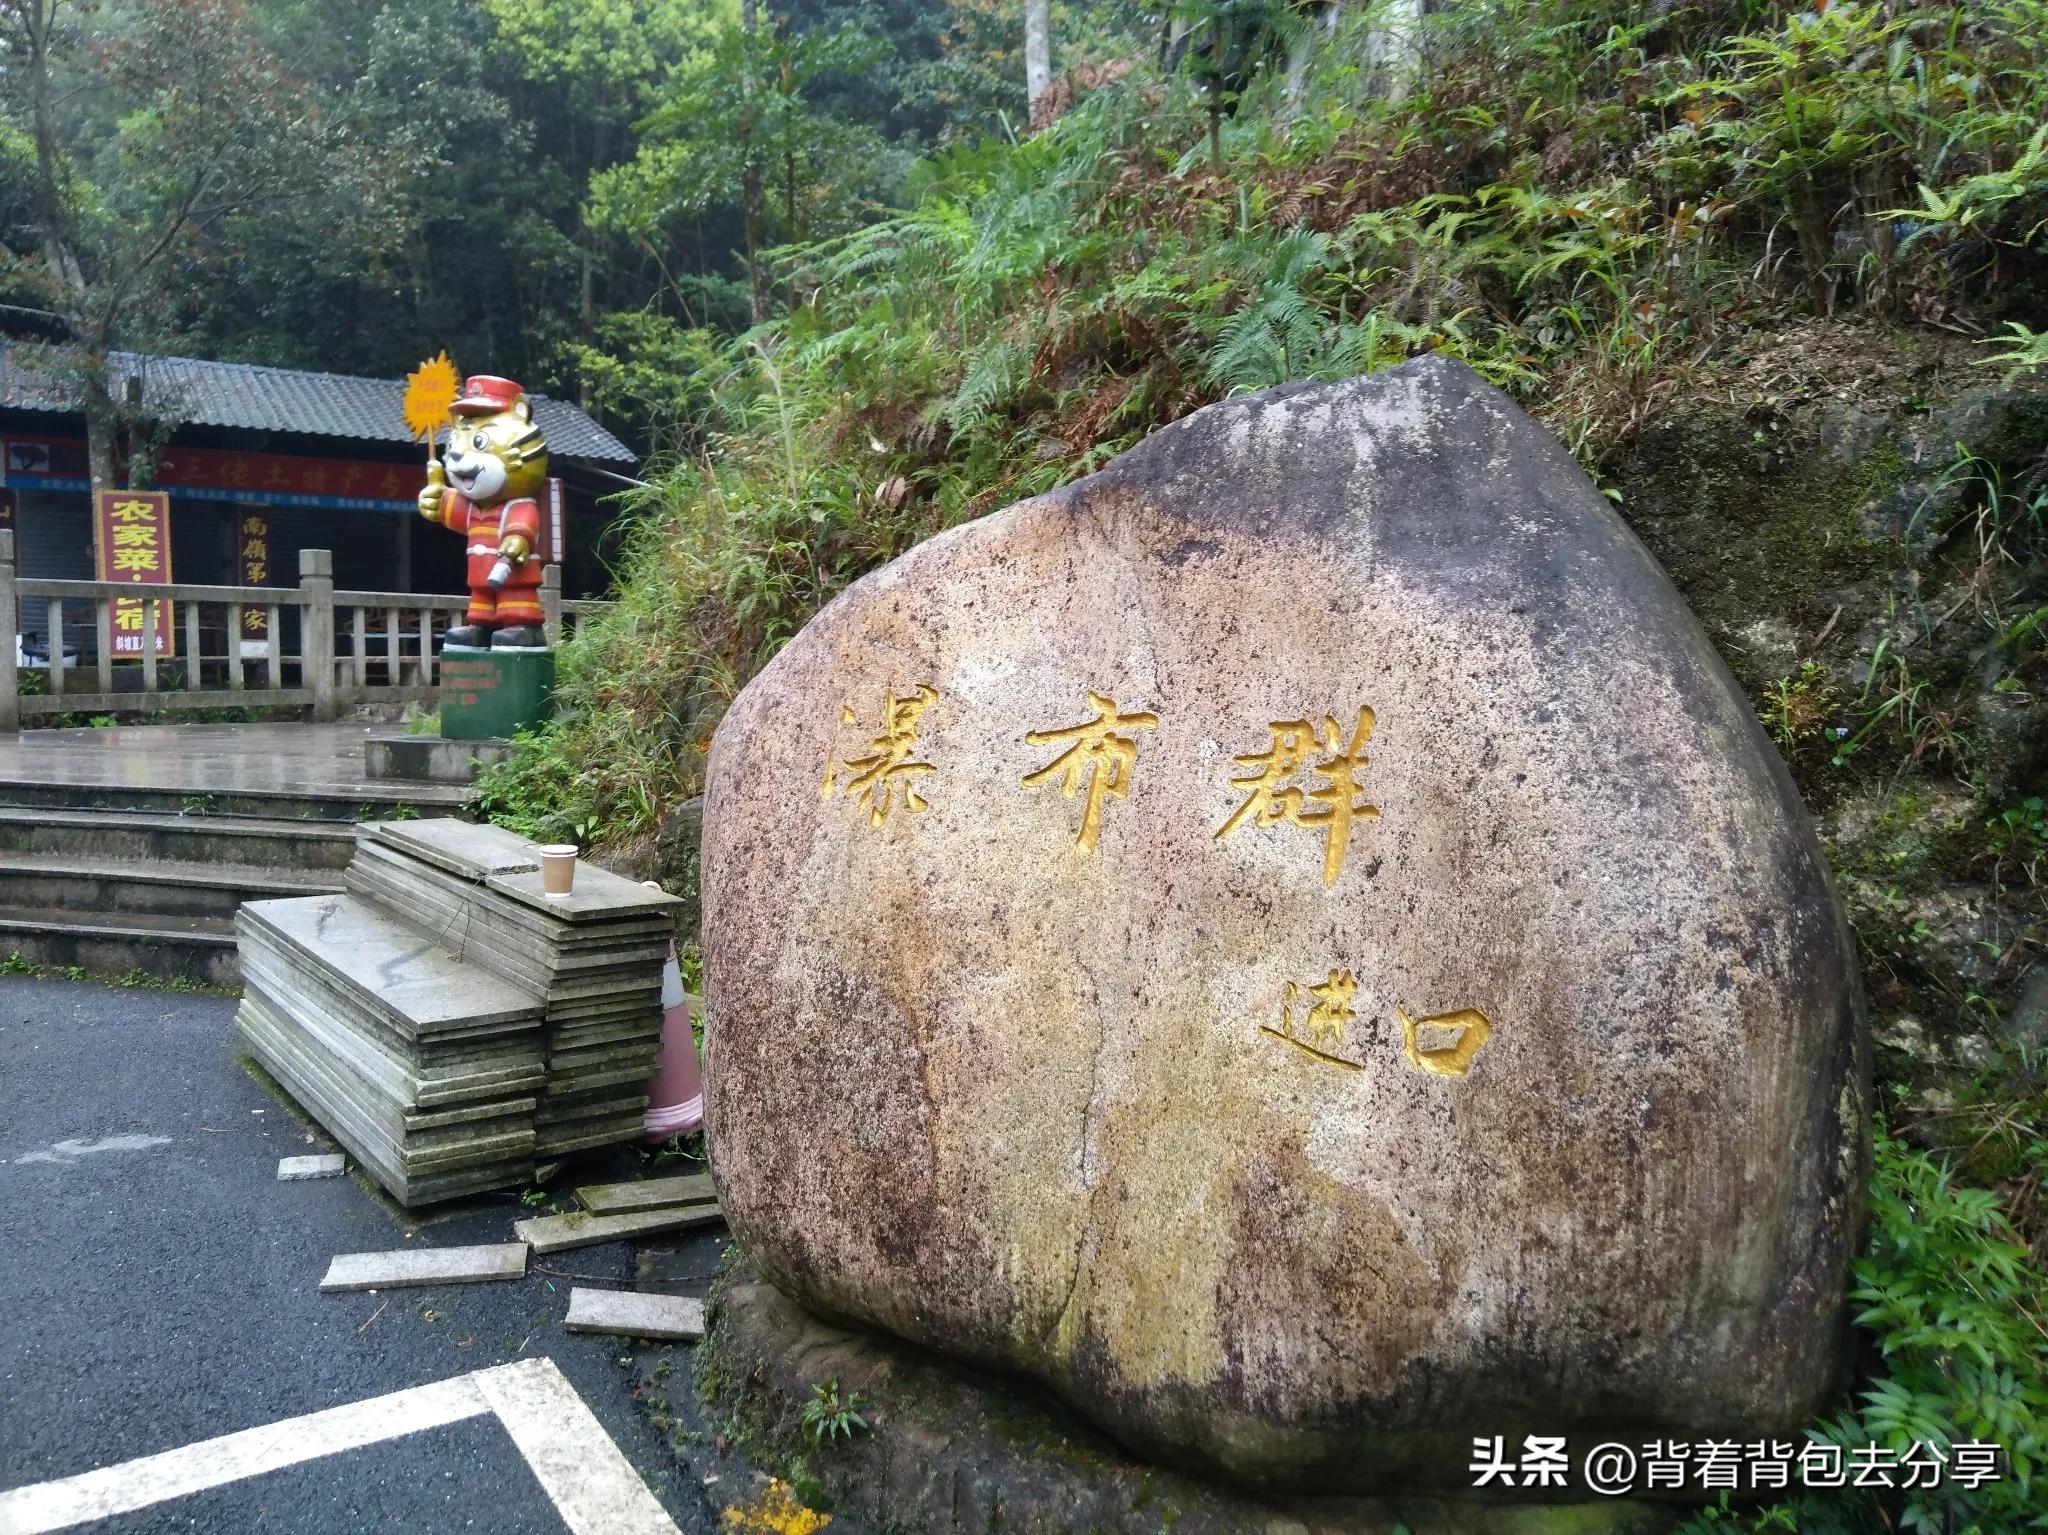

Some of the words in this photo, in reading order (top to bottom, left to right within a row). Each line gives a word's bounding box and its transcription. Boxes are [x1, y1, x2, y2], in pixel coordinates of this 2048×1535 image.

[110, 499, 161, 630] 农家菜·宿
[821, 683, 1383, 886] 瀑布群
